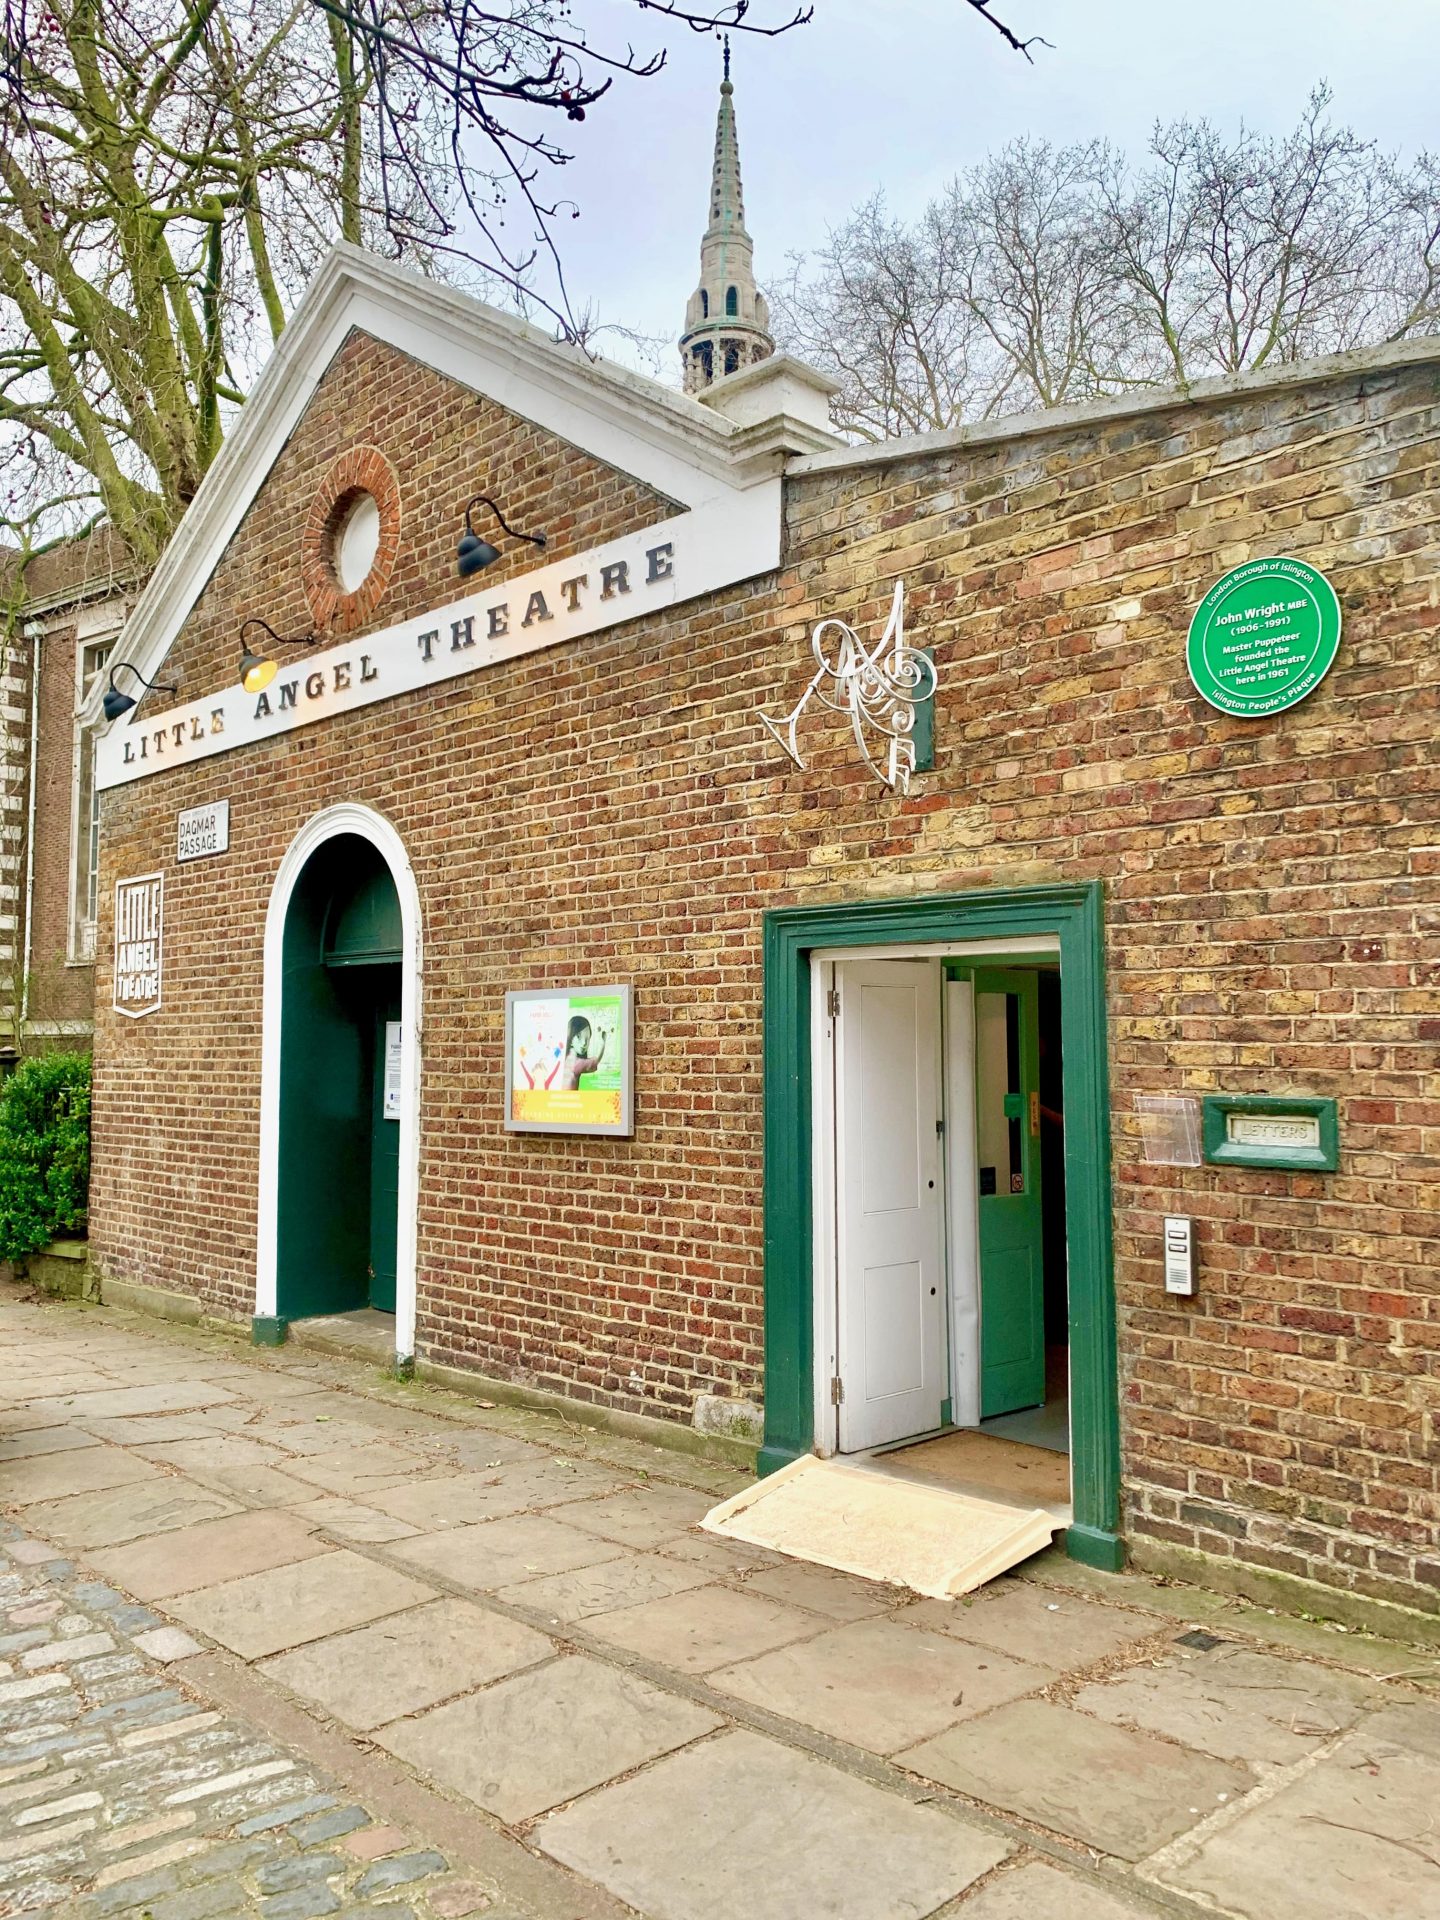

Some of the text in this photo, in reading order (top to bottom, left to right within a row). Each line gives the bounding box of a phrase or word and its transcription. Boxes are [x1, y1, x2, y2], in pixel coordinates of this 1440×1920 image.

[1206, 562, 1314, 606] London Borough of Islington
[1215, 599, 1308, 626] John Wright MBE
[123, 542, 675, 764] LITTLE ANGEL THEATRE
[1222, 632, 1301, 654] Master Puppeteer
[1234, 646, 1290, 663] founded the
[1219, 655, 1306, 677] Little Angel Theatre
[1235, 668, 1289, 685] here in 1961
[1211, 672, 1316, 710] Islington People's Plaque
[180, 815, 216, 838] DAGMAR
[179, 833, 217, 857] PASSAGE
[118, 882, 160, 943] LITTLE
[117, 940, 158, 973] ANGEL
[117, 970, 158, 1001] THEATRE
[1241, 1121, 1308, 1139] LETTERS
